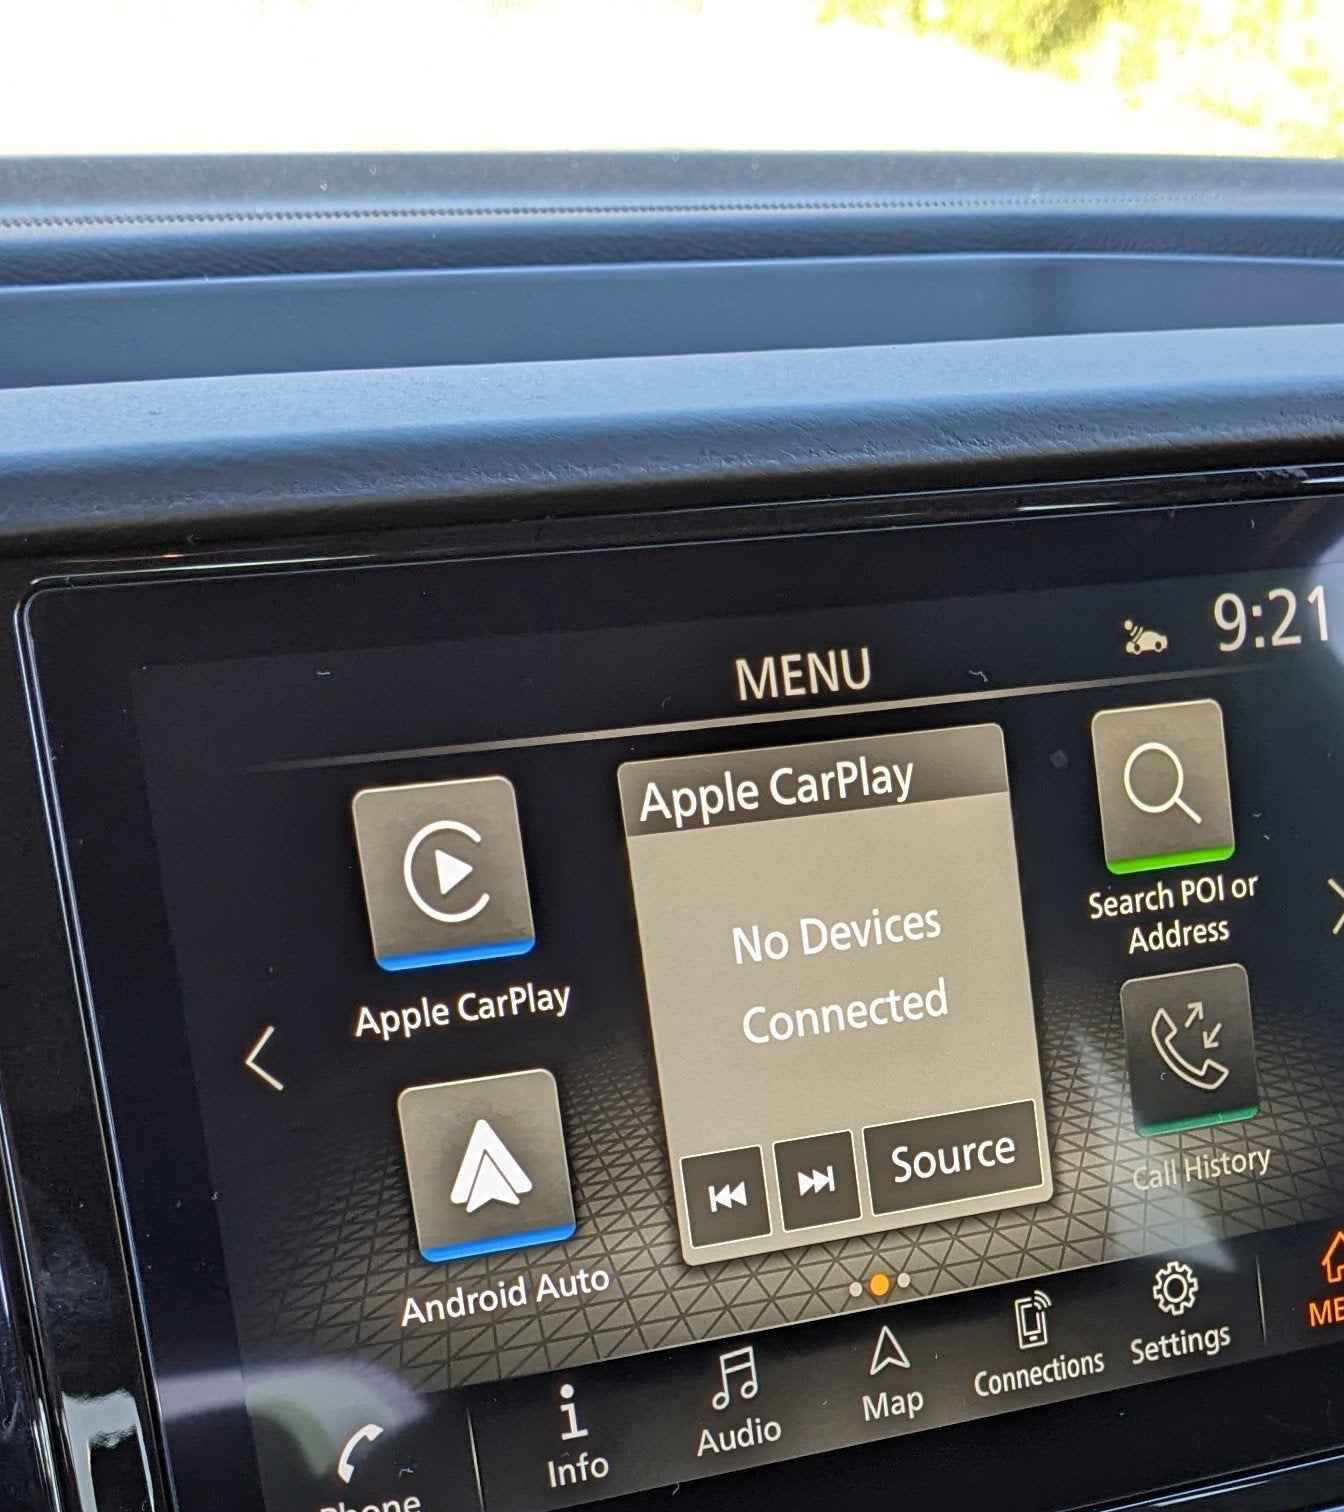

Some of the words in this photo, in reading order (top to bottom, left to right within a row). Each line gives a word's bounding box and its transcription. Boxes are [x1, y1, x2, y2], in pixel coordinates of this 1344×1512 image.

[1213, 584, 1330, 652] 9:21
[735, 648, 871, 701] MENU
[639, 771, 759, 828] Apple
[769, 757, 914, 806] CarPlay
[1089, 881, 1174, 919] Search
[1181, 874, 1225, 907] POI
[1231, 875, 1259, 898] or
[732, 925, 789, 964] No
[800, 908, 941, 955] Devices
[1128, 919, 1230, 955] Address
[355, 997, 450, 1041] Apple
[457, 982, 571, 1021] CarPlay
[742, 977, 948, 1043] Connected
[891, 1136, 1016, 1183] Source
[1133, 1158, 1178, 1191] Call
[1184, 1149, 1271, 1182] History
[400, 1276, 527, 1327] Android
[536, 1269, 610, 1304] Auto
[1130, 1324, 1231, 1367] Settings
[974, 1350, 1105, 1400] Connections
[862, 1388, 924, 1422] Map
[696, 1418, 783, 1458] Audio
[546, 1453, 610, 1489] Info
